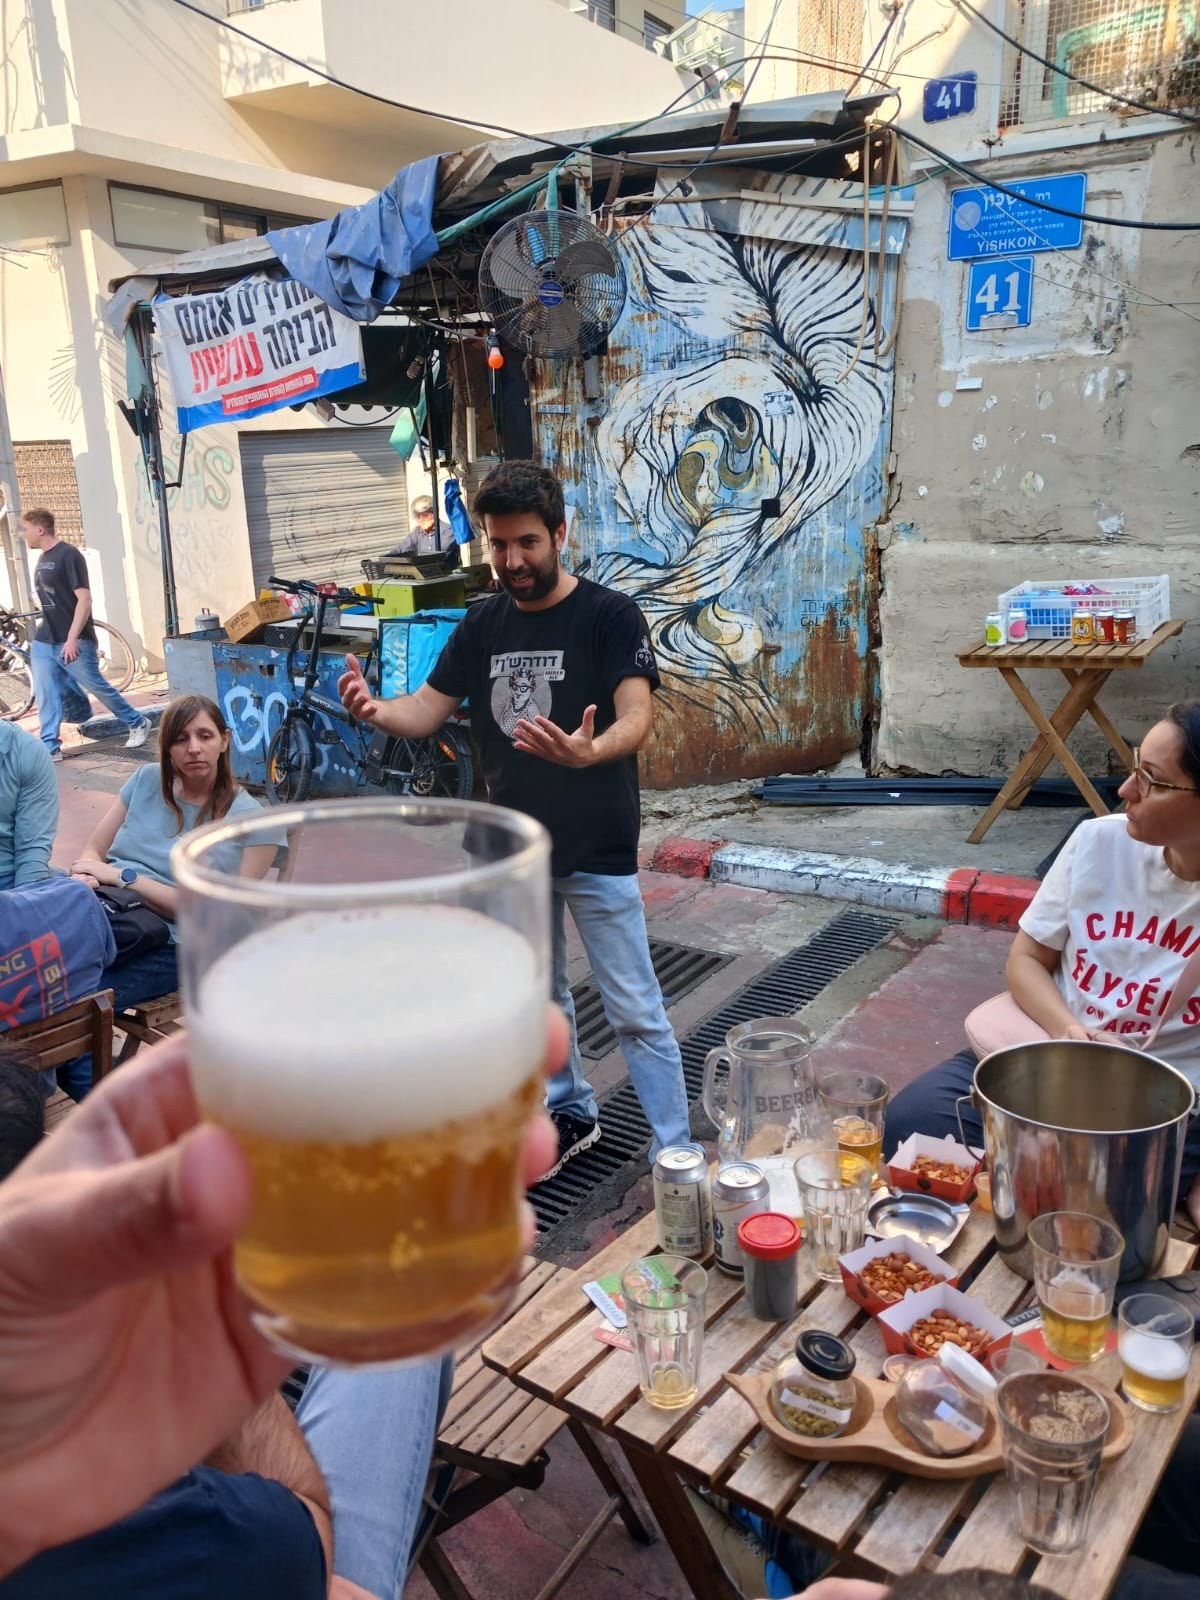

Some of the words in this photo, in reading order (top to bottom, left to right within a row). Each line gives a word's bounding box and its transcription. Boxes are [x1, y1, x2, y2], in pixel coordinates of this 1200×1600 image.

[936, 82, 961, 109] 41
[977, 235, 1037, 253] YISHKON
[975, 271, 1022, 312] 41
[174, 295, 236, 346] אותם
[262, 302, 337, 370] הביתה
[0, 953, 27, 981] YC
